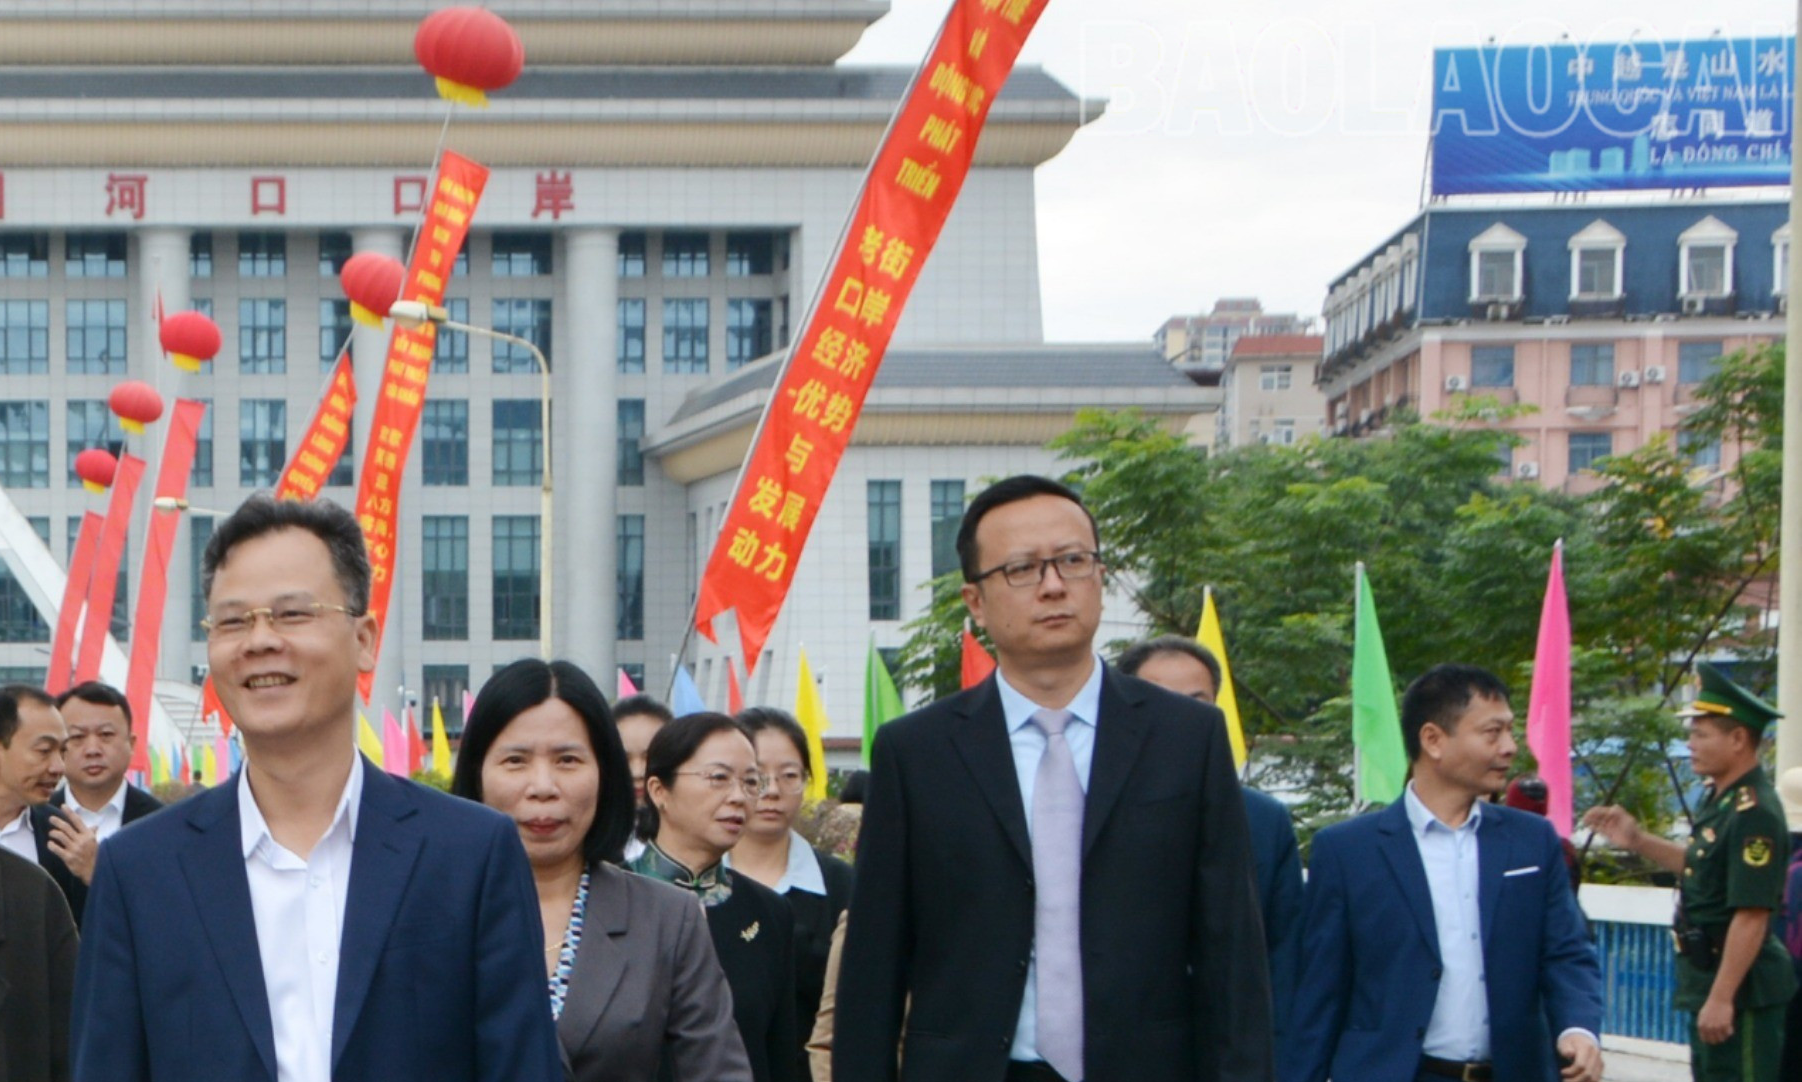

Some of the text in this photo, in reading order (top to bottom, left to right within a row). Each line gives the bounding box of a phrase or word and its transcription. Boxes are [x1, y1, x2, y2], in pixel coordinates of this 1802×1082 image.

[919, 113, 962, 156] PHÁT
[1746, 139, 1782, 161] CHÍ
[895, 157, 942, 200] TRIỂN
[834, 276, 892, 327] 口岸
[810, 326, 871, 381] 经济
[785, 432, 814, 475] 与
[748, 475, 807, 533] 发展
[727, 527, 788, 582] 动力
